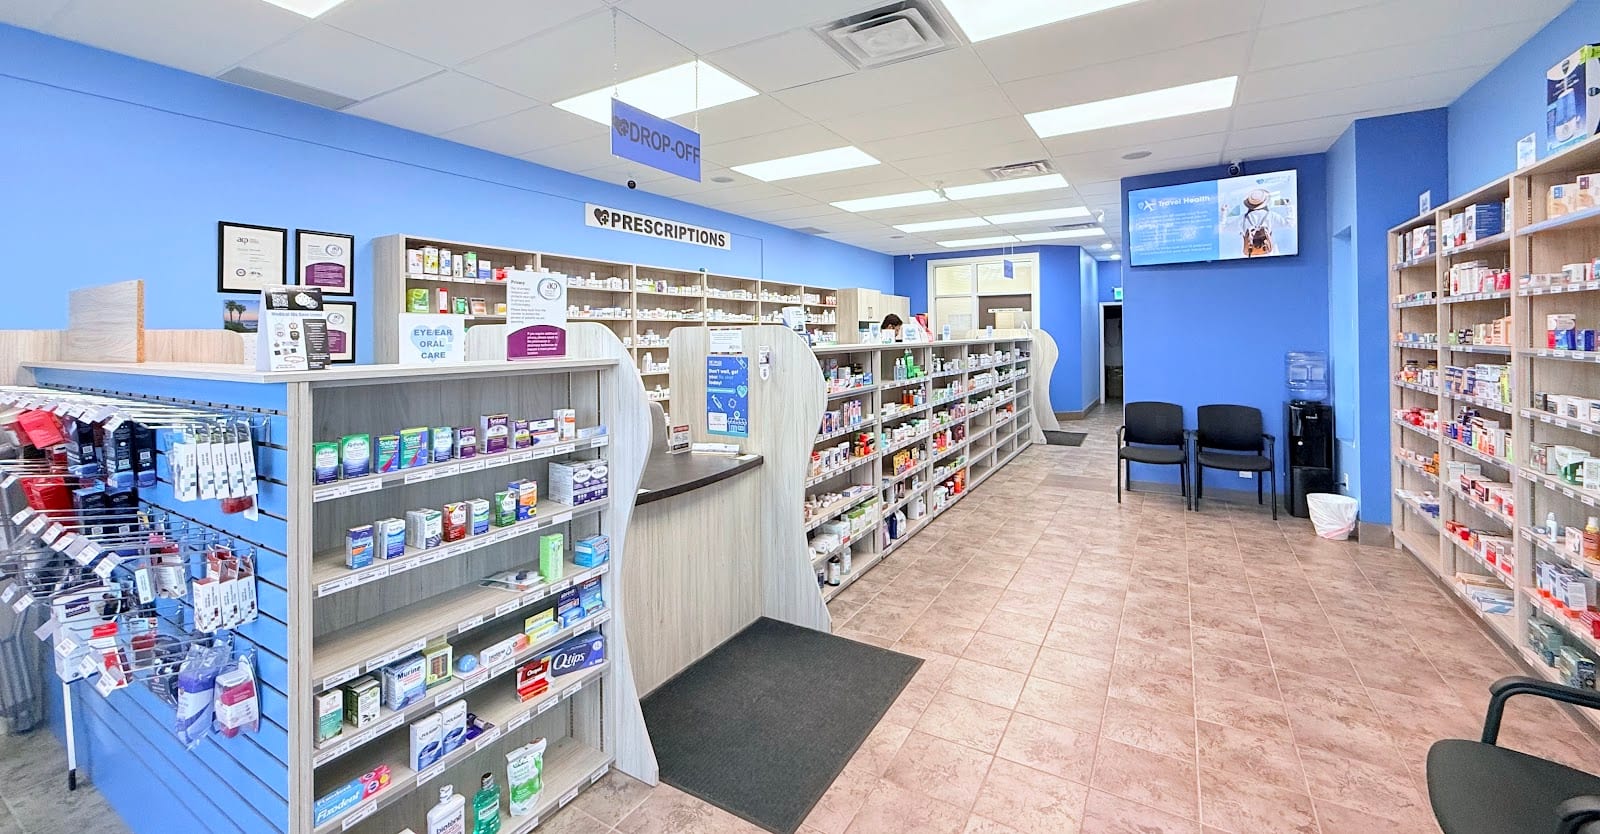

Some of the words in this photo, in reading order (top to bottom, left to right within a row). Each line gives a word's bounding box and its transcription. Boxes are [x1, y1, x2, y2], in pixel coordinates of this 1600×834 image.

[630, 122, 700, 164] DROP-OFF
[1158, 199, 1182, 208] Travel
[1183, 195, 1210, 205] Health
[611, 212, 725, 247] PRESCRIPTIONS
[419, 340, 445, 348] ORAL
[421, 351, 446, 359] CARE
[397, 666, 421, 679] Murine
